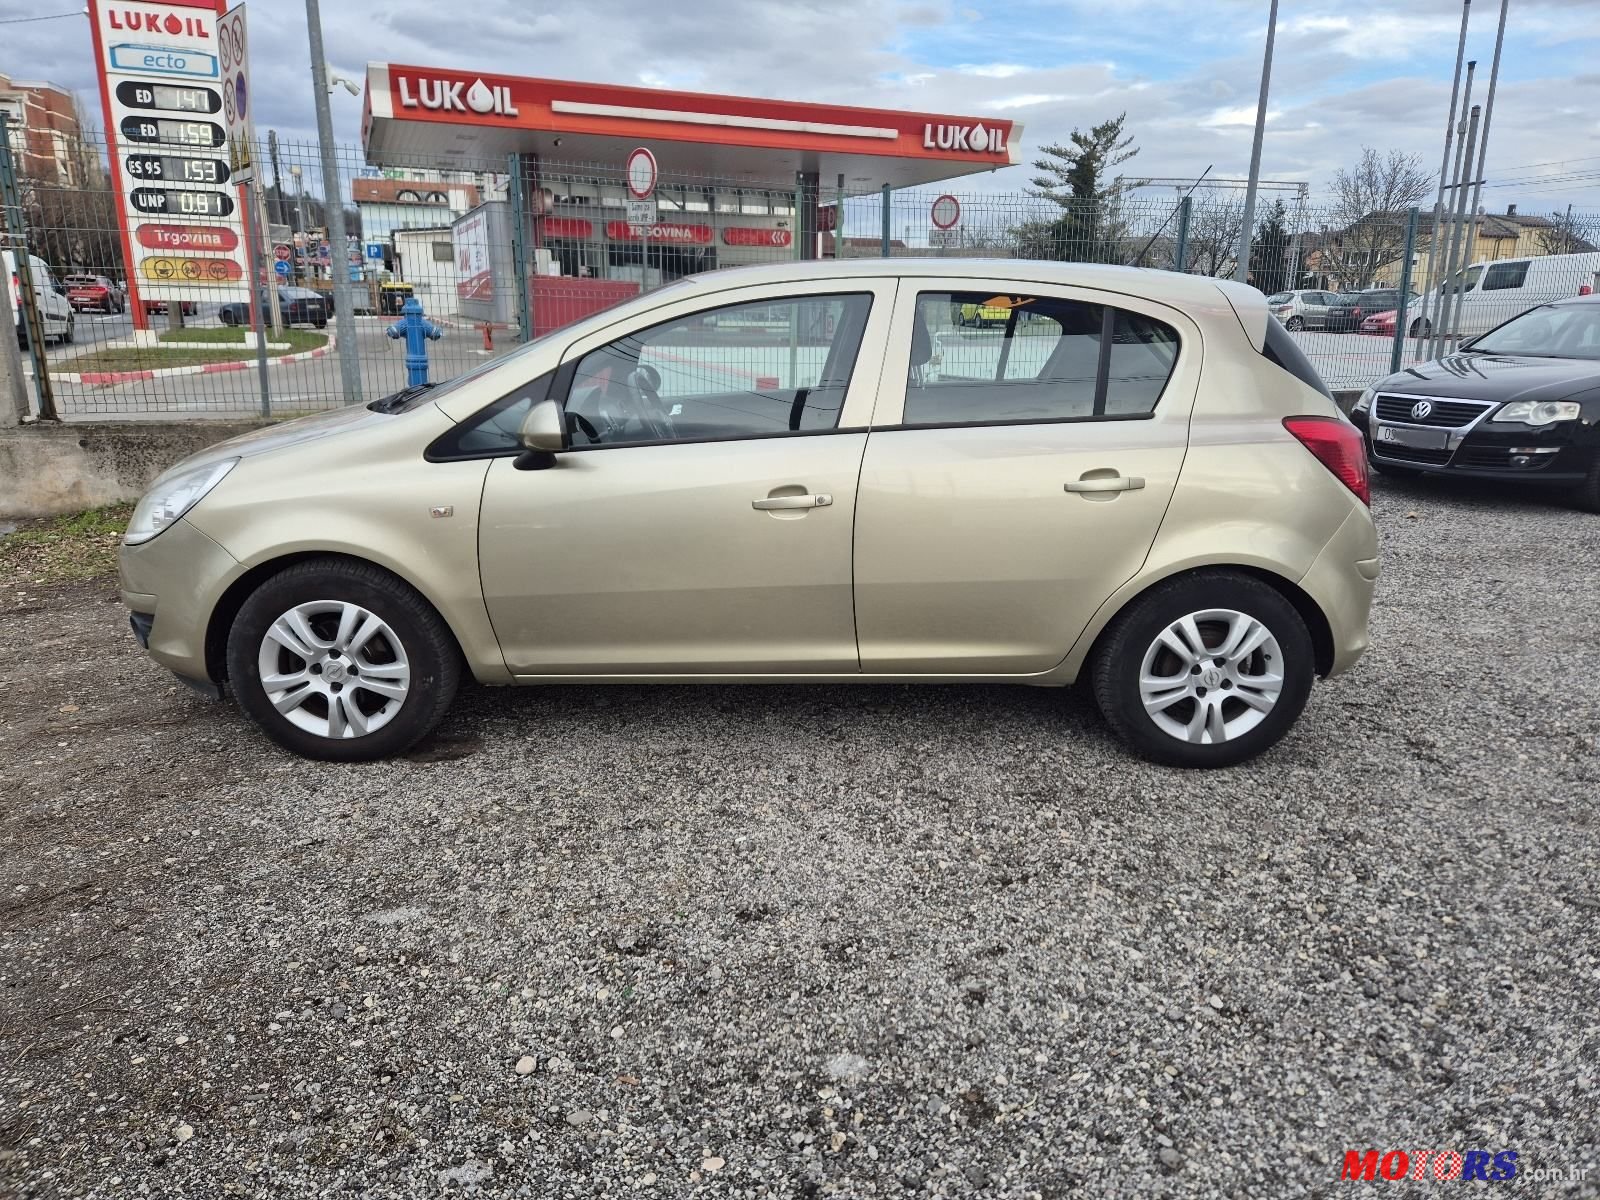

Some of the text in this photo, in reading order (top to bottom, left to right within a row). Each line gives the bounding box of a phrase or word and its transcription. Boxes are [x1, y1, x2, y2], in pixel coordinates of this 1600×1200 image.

[108, 9, 209, 38] LUKOIL
[143, 54, 186, 69] ecto
[135, 89, 209, 110] ED 1.47
[398, 76, 519, 117] LUKOIL
[140, 123, 157, 136] ED
[923, 122, 1007, 153] LUKOIL
[128, 160, 217, 181] ES 95 1.53
[138, 194, 165, 207] UNP
[154, 230, 221, 245] Trgovina
